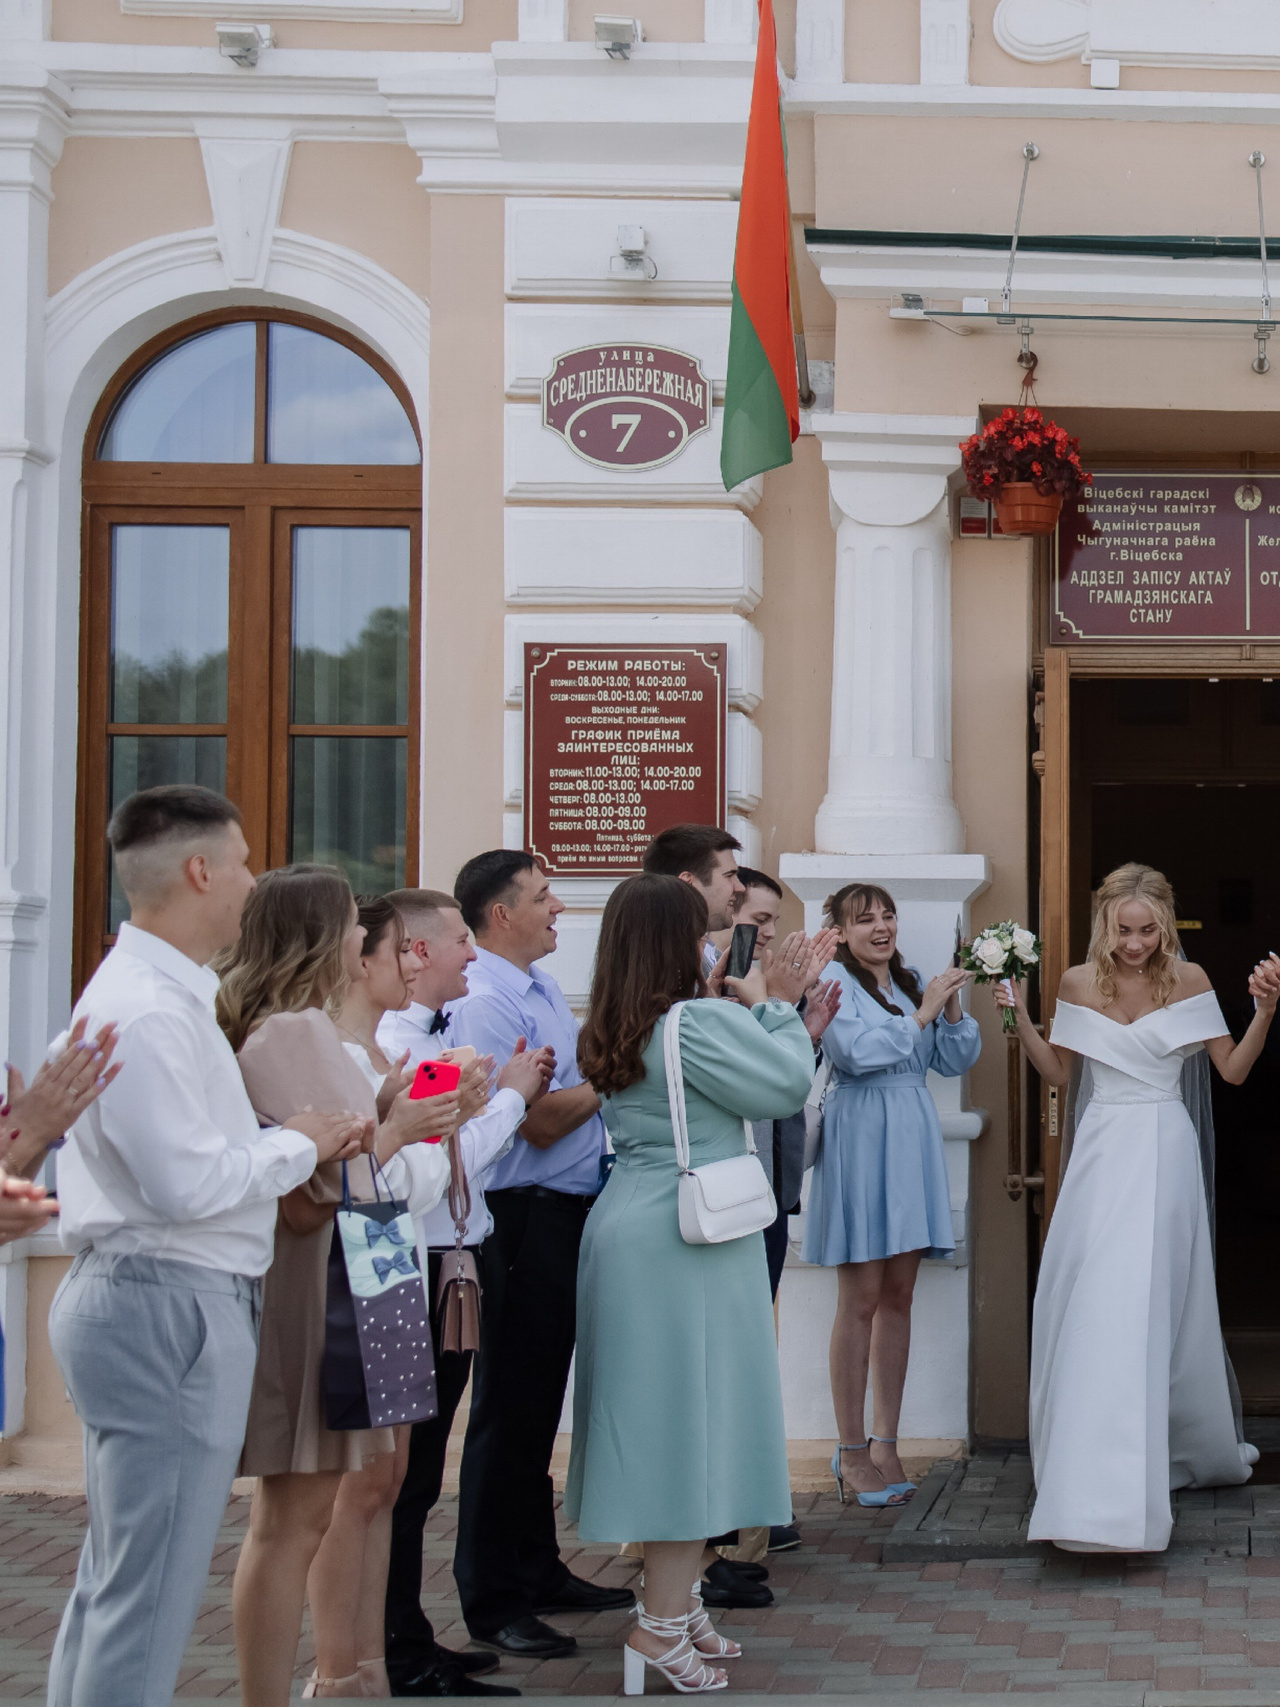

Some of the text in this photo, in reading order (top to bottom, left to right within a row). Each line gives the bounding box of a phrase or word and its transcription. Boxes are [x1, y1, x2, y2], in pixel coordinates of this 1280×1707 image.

[599, 350, 655, 365] улица
[550, 367, 704, 409] СРЕДНЕНАБЕРЕЖНАЯ
[611, 413, 642, 453] 7
[1084, 487, 1210, 501] Віцебскі гарадскі
[1077, 503, 1217, 516] выканаўчы камітэт
[1092, 519, 1201, 532] Адміністрацыя
[1077, 535, 1216, 548] Чыгуначнага раёна
[1110, 549, 1183, 562] г.Віцебска
[1070, 568, 1232, 587] АДДЗЕЛ ЗАПІСУ АКТАЎ
[1089, 590, 1213, 606] ГРАМАДЗЯНСКАГА
[1129, 609, 1173, 623] СТАНУ
[567, 660, 686, 671] РЕЖИМ РАБОТЫ:
[636, 676, 687, 687] 14.00-20.00
[655, 690, 703, 701] 14.00-17.00
[592, 706, 660, 714] ВЫХОДНЫЕ ДНИ:
[565, 717, 625, 725] ВОСКРЕСЕНЬЕ,
[571, 728, 680, 740] ГРАФИК ПРИЁМА
[558, 743, 694, 753] ЗАИНТЕРЕСОВАННЫХ
[611, 755, 640, 767] ЛИЦ:
[644, 766, 702, 778] 14.00-20.00
[640, 780, 694, 791] 14.00-17.00
